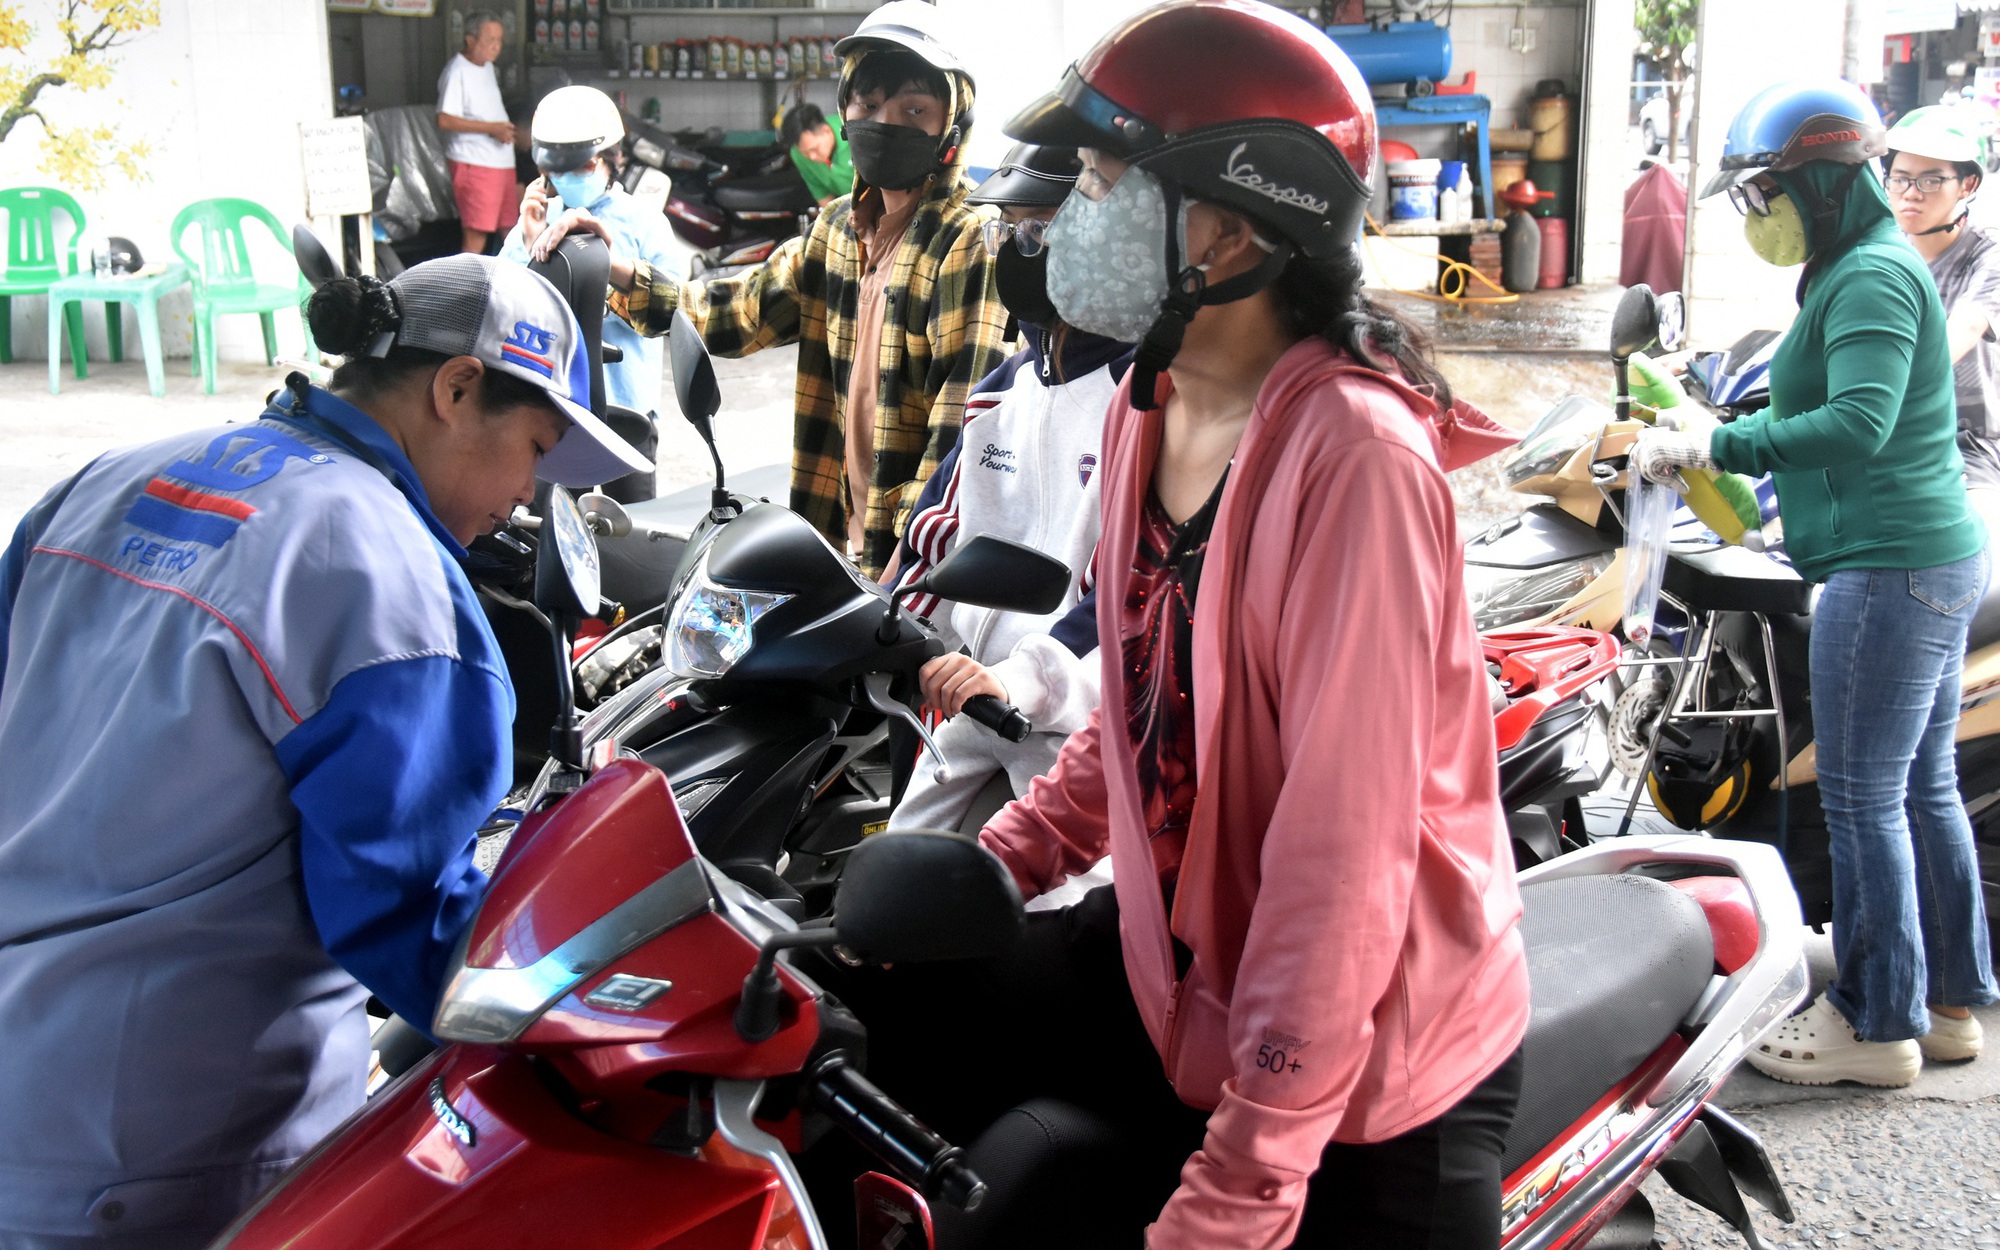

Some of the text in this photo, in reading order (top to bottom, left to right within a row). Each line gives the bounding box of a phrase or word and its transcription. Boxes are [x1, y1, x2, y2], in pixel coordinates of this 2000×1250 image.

[1801, 130, 1862, 147] HONDA
[504, 320, 551, 356] STS
[163, 425, 337, 492] STS
[119, 535, 198, 573] PETRO
[600, 978, 663, 1000] FI
[1256, 1043, 1302, 1074] 50+
